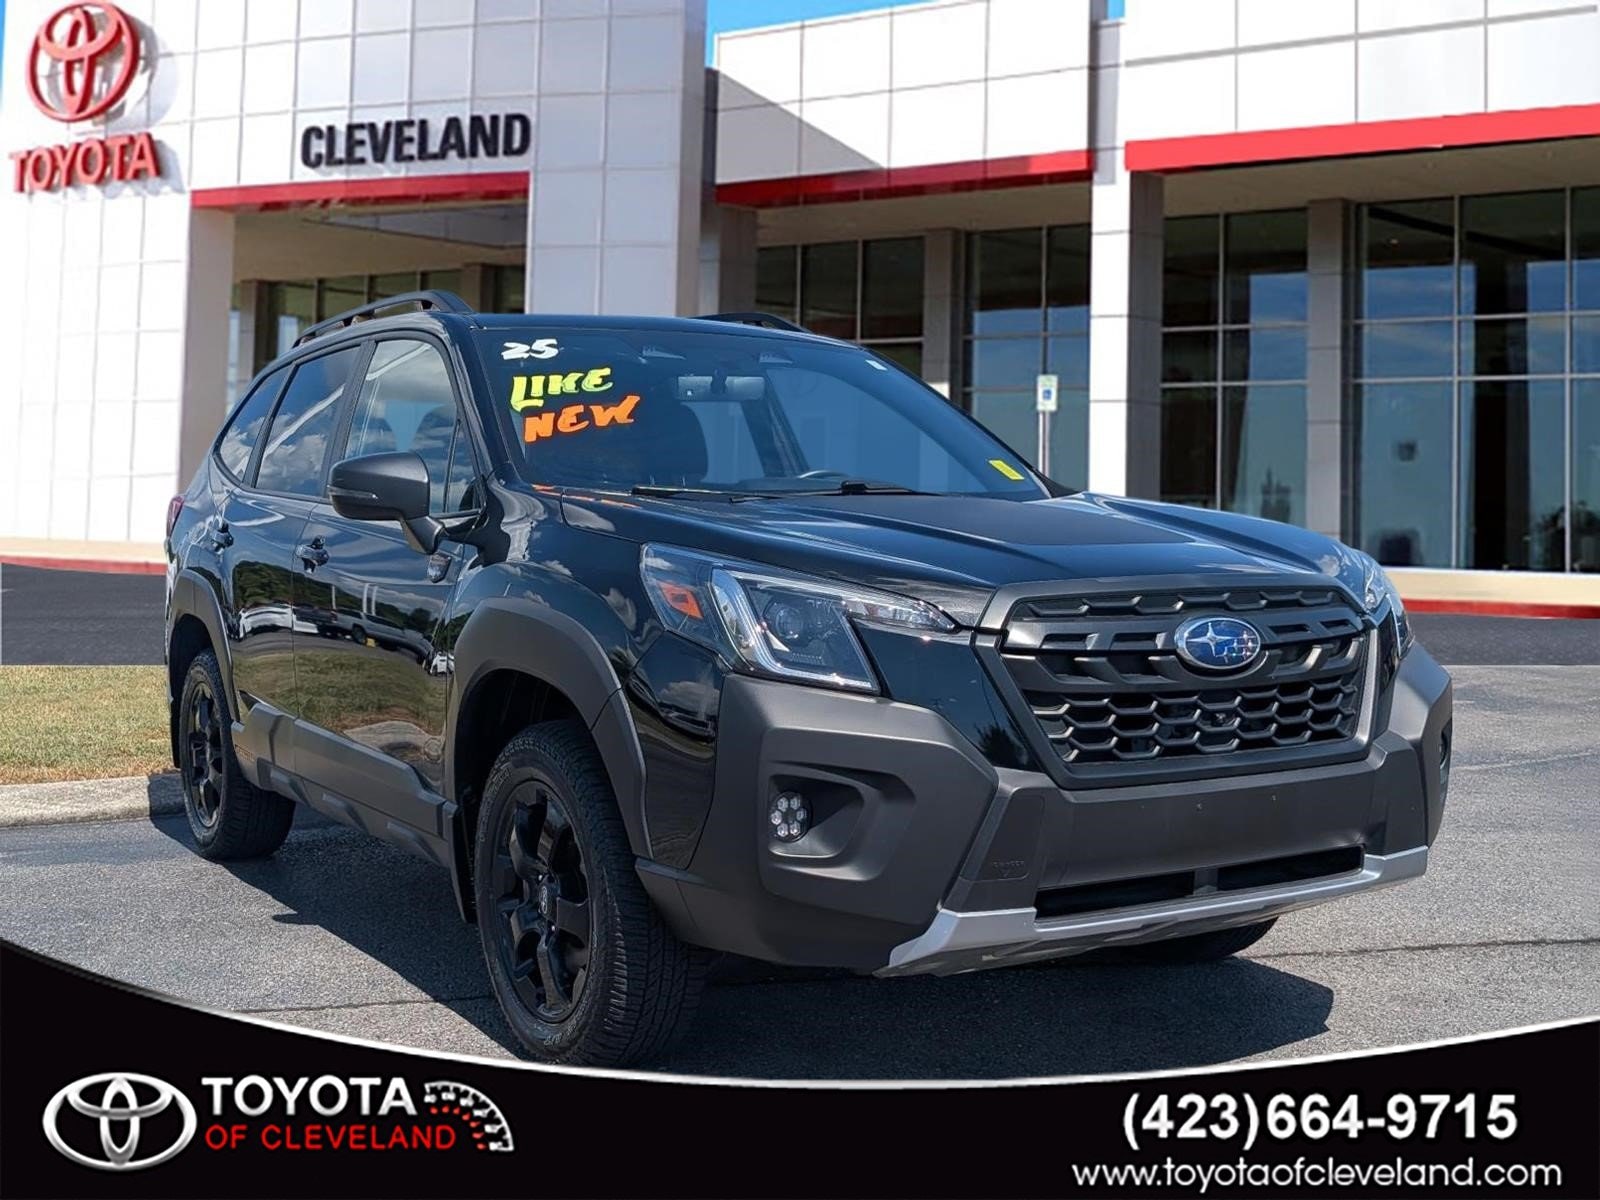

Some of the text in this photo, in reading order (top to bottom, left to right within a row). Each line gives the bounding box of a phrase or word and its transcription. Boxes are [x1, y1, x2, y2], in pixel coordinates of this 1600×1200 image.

[9, 131, 163, 193] TOYOTA
[301, 113, 531, 169] CLEVELAND
[501, 338, 559, 361] 25
[510, 367, 614, 413] LIKE
[524, 395, 641, 443] NEW
